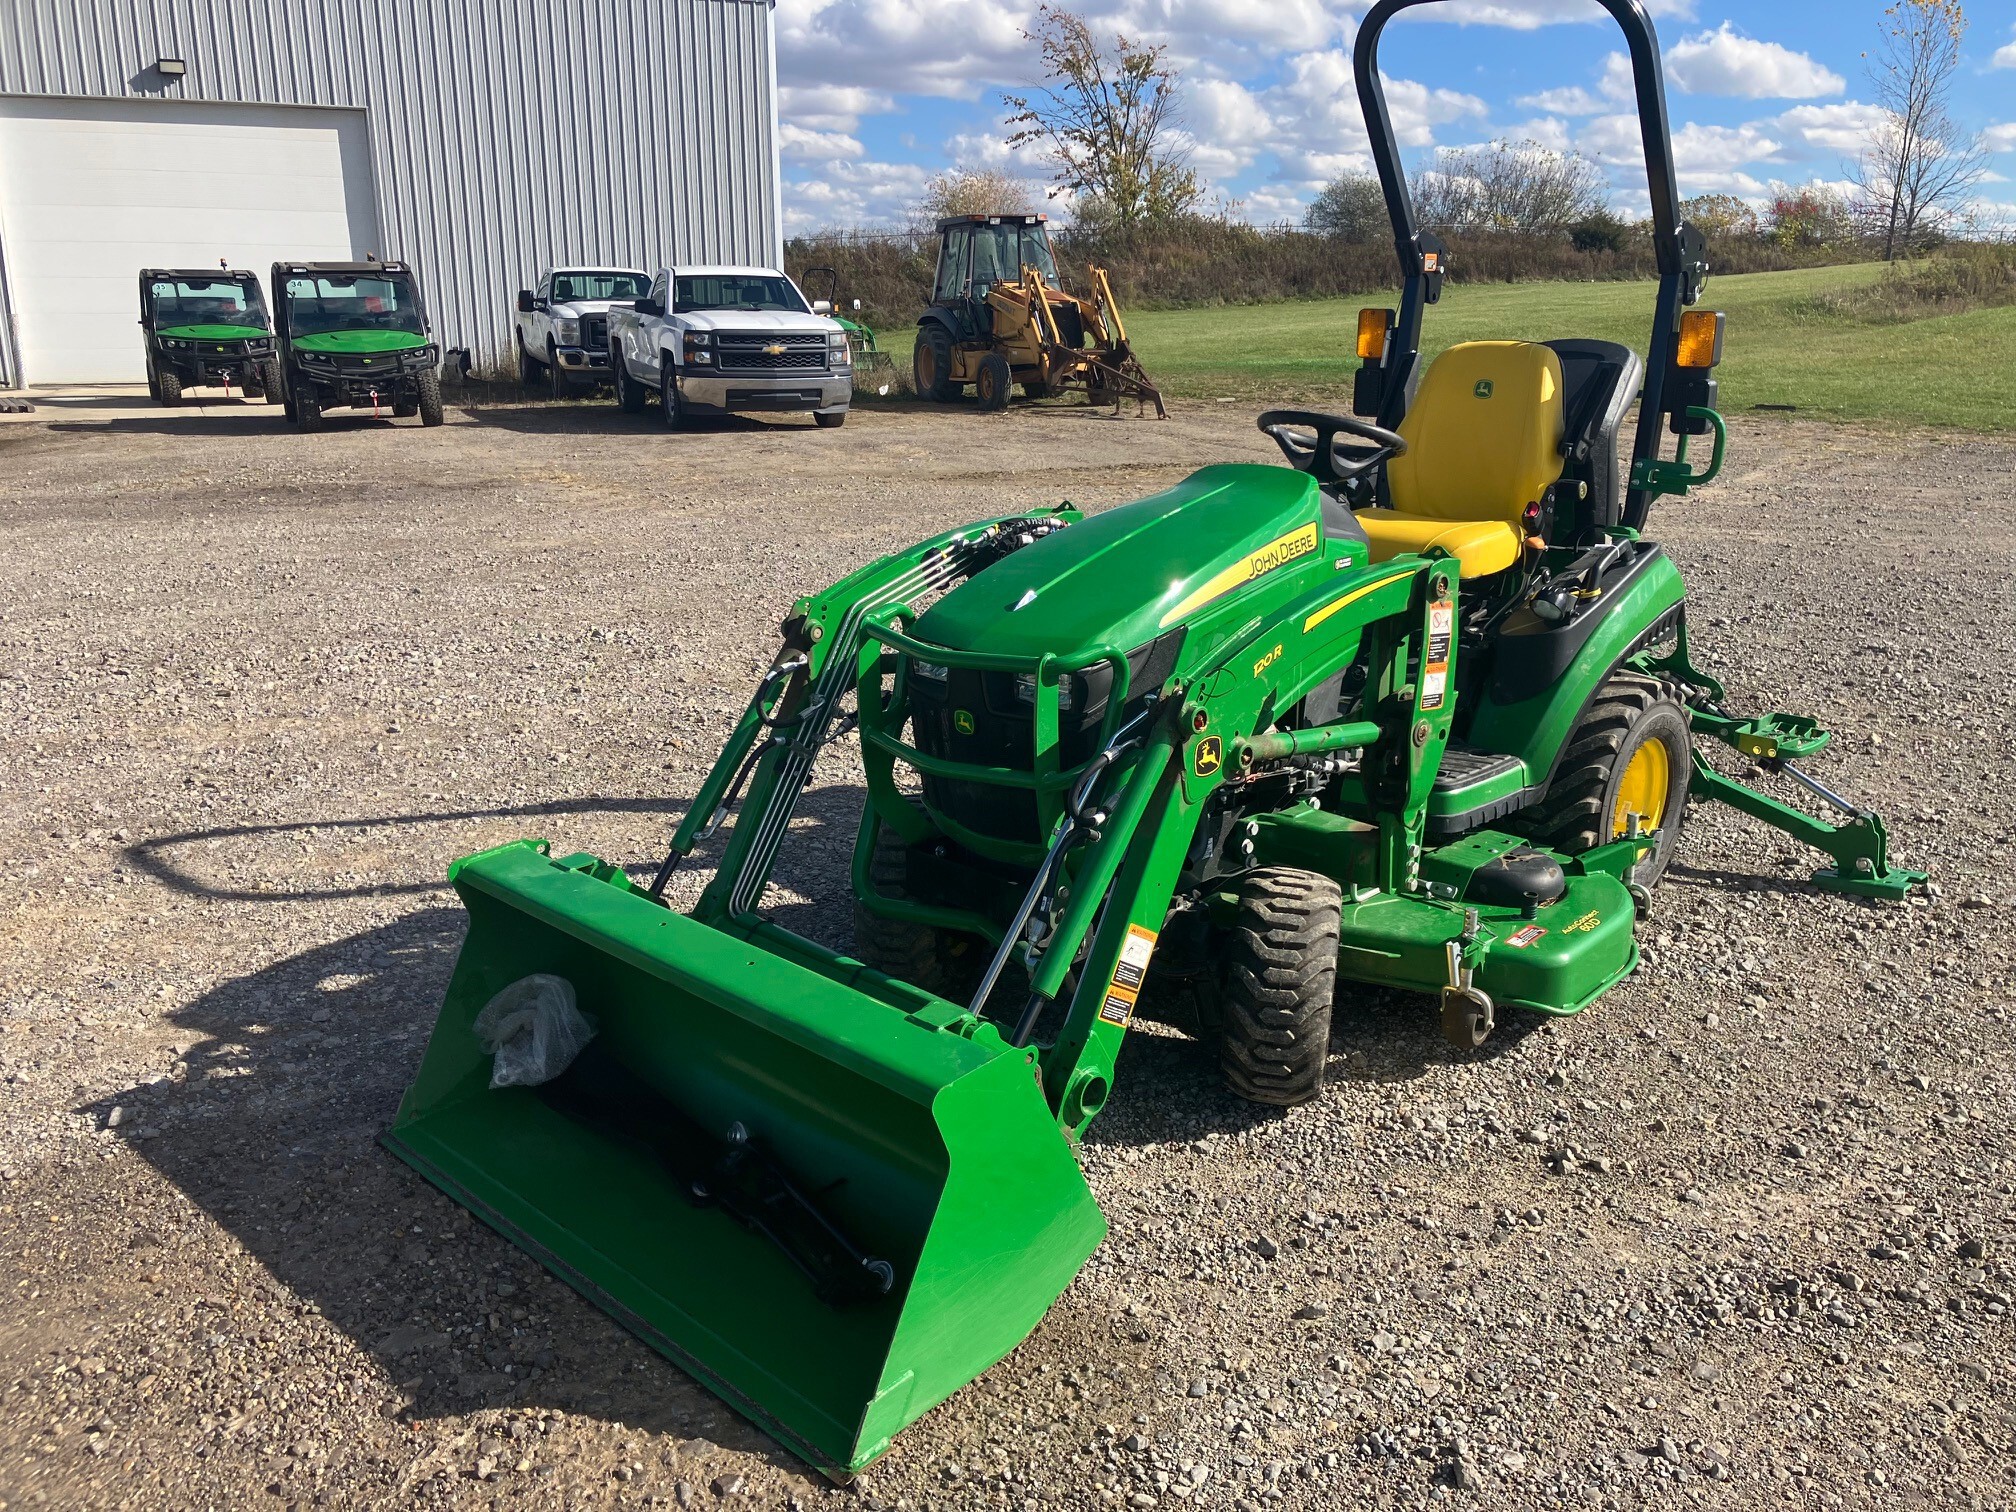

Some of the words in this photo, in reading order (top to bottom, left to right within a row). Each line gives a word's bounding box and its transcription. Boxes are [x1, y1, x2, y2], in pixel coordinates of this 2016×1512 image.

[291, 280, 303, 288] 34
[1249, 550, 1279, 578] JOHN
[1279, 534, 1314, 561] DEERE
[1579, 918, 1601, 932] 60D
